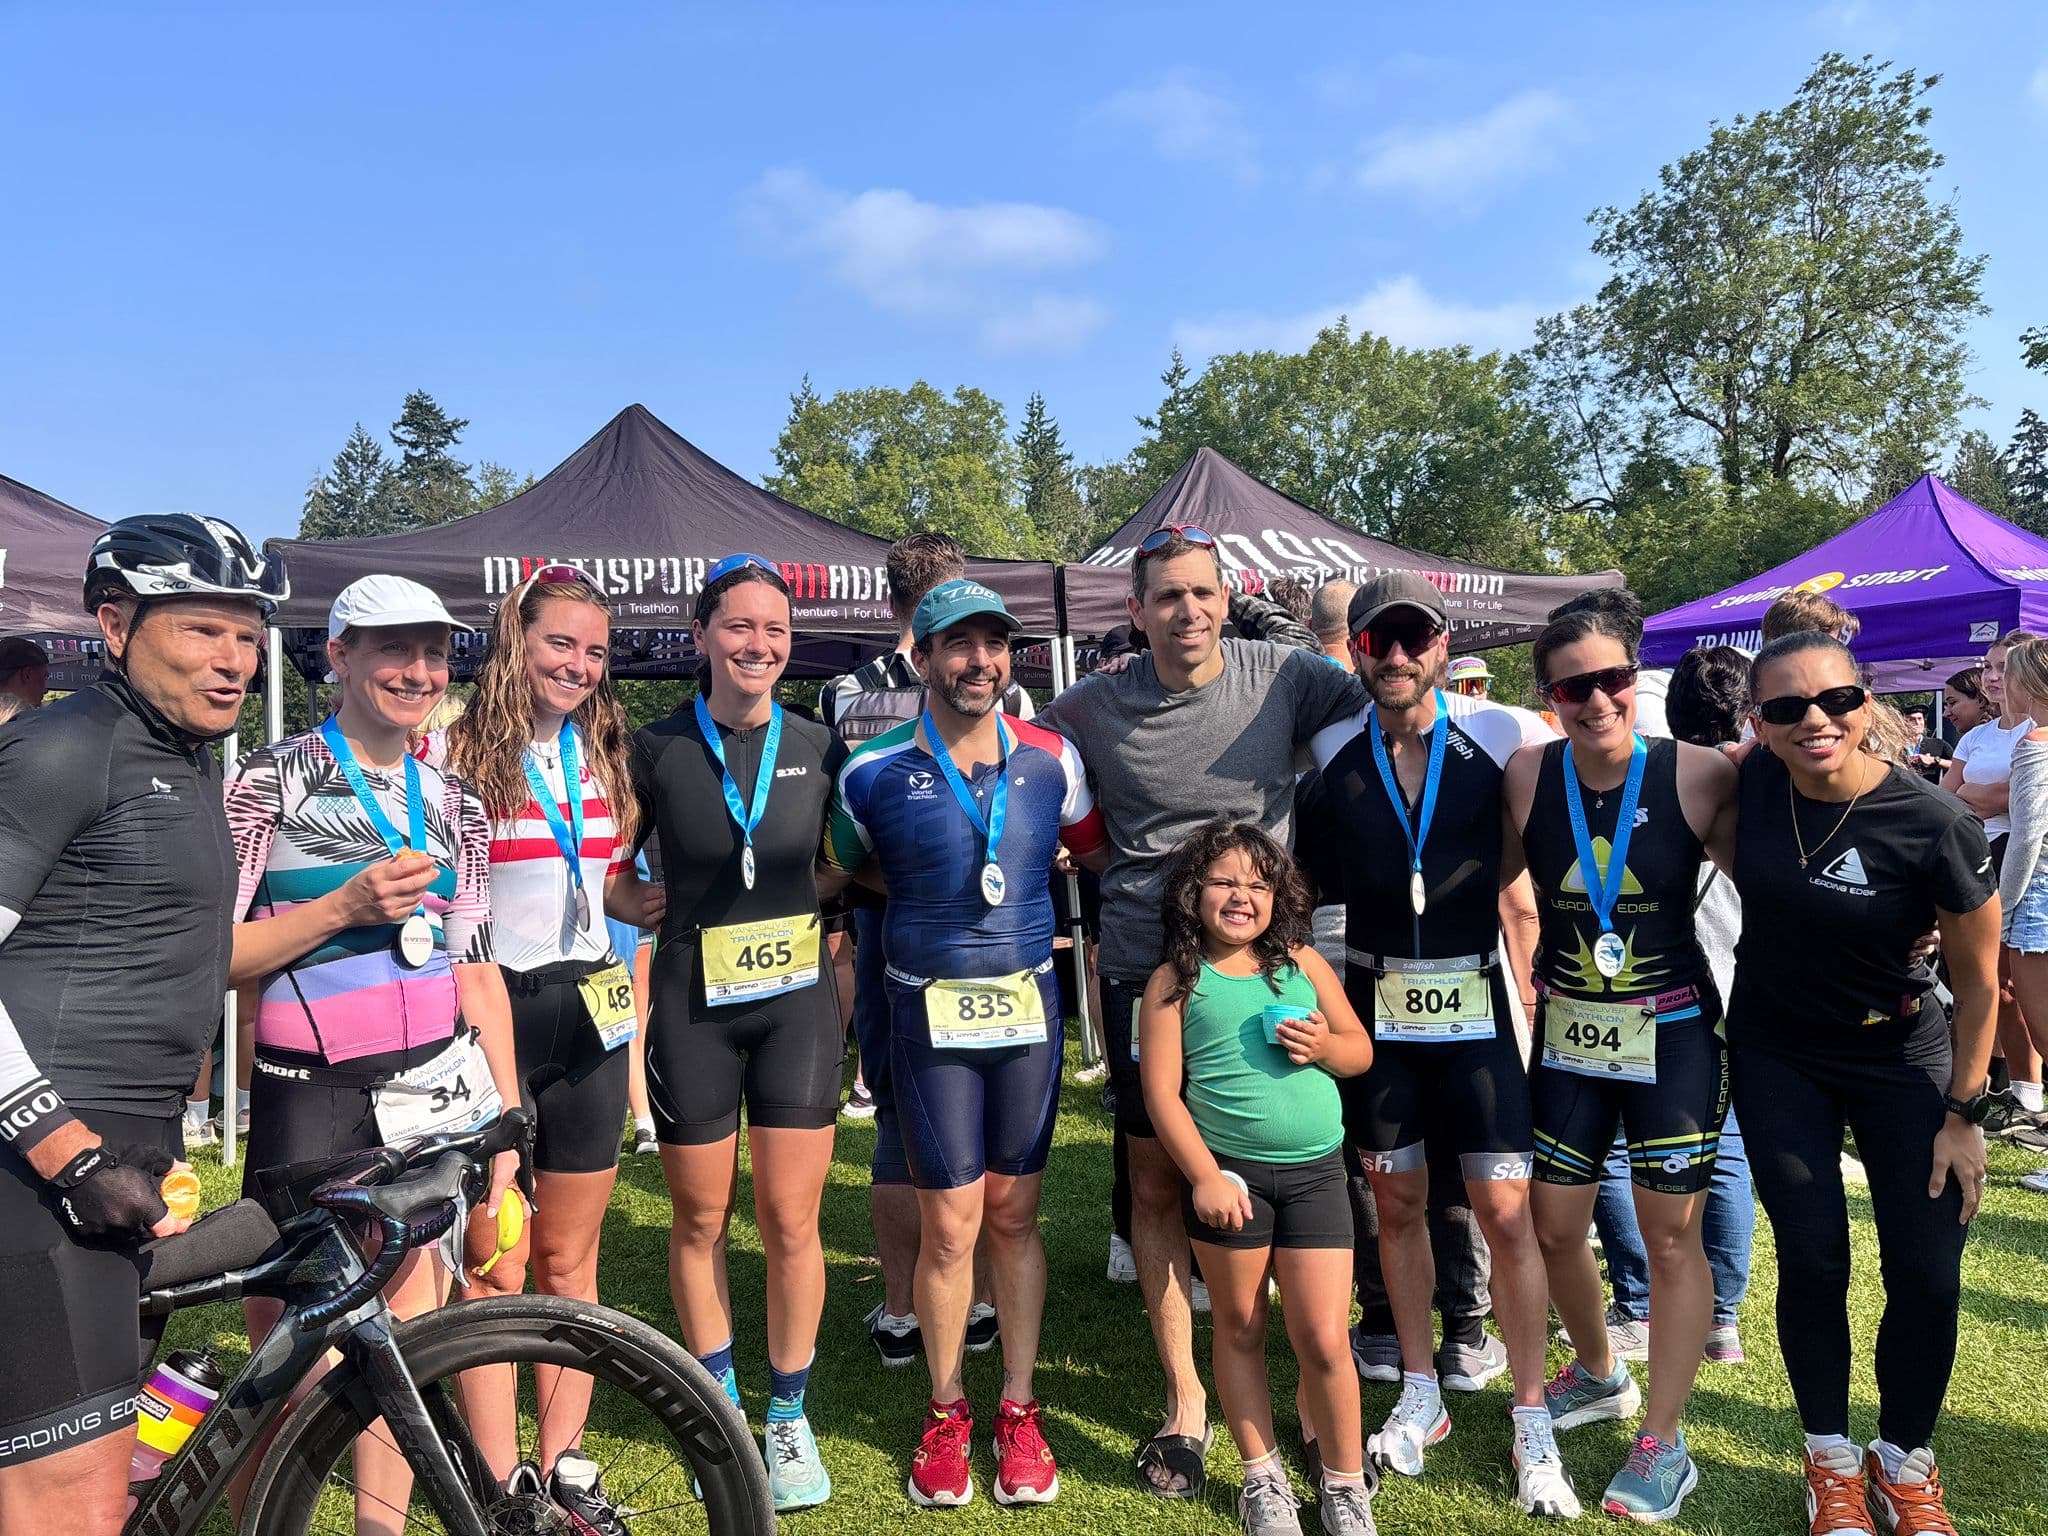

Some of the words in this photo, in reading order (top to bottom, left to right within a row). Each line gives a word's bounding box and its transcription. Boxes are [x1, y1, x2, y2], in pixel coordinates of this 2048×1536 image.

[1841, 565, 1950, 588] smart
[629, 602, 679, 616] Triathlon
[791, 606, 838, 618] dventure
[1473, 600, 1486, 610] For
[1488, 600, 1503, 611] Life
[854, 607, 872, 618] For
[874, 608, 893, 620] Life
[1808, 876, 1847, 892] LEADING
[1849, 886, 1877, 897] EDGE
[1617, 902, 1660, 914] EDGE
[727, 920, 796, 935] VANCOUVER
[730, 929, 794, 944] TRIATHLON
[736, 941, 792, 971] 465
[1402, 961, 1435, 972] sailfish
[1402, 977, 1465, 985] TRIATHLON
[607, 984, 631, 1013] 48
[1405, 988, 1462, 1014] 804
[958, 993, 1014, 1021] 835
[1563, 1008, 1624, 1023] TRIATHLON
[1565, 1021, 1622, 1052] 494
[415, 1055, 466, 1089] RIATHLON
[429, 1074, 472, 1114] 34
[1714, 1049, 1730, 1124] LEADING
[1546, 1174, 1574, 1183] EDGE
[1656, 1184, 1688, 1192] EDGE
[0, 1412, 101, 1457] EADING
